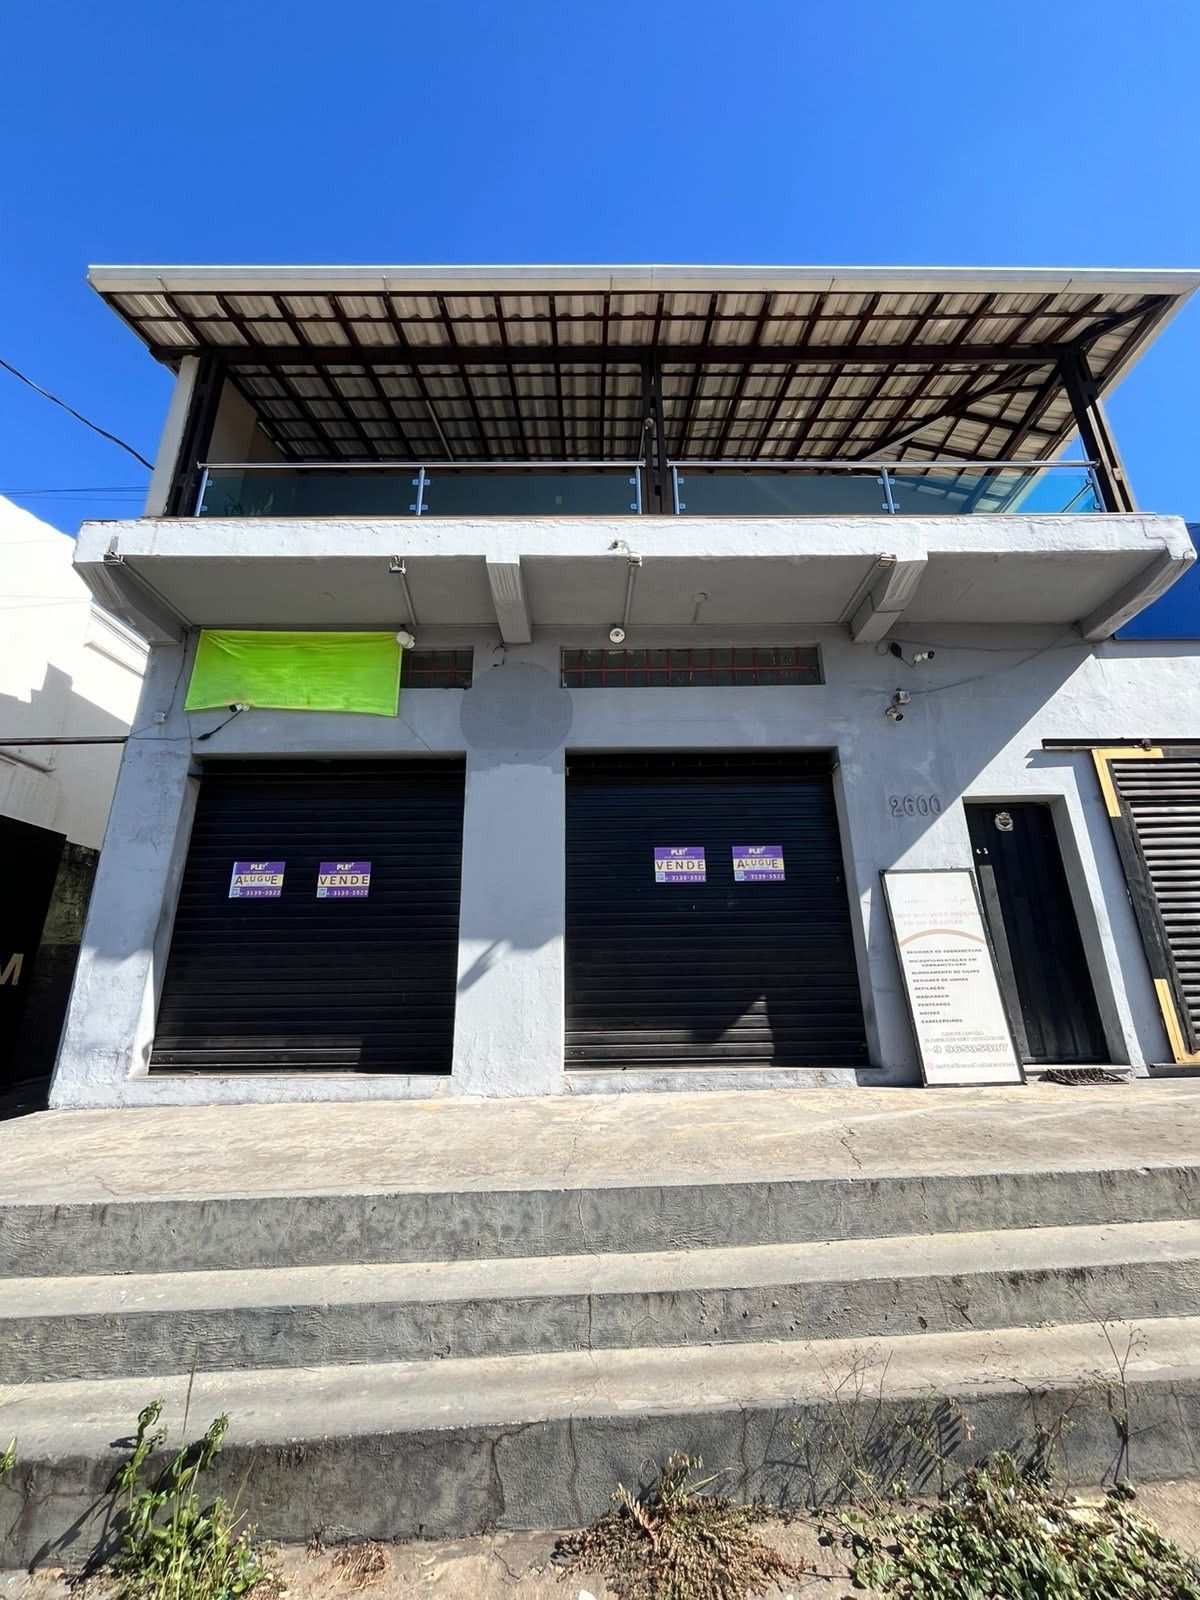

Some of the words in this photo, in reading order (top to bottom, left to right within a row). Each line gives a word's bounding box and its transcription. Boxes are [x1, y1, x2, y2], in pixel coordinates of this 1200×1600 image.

[888, 794, 942, 818] 2600
[656, 861, 704, 870] VENDE
[737, 859, 779, 869] ALUGUE
[235, 875, 278, 885] ALUGUE
[320, 876, 368, 885] VENDE
